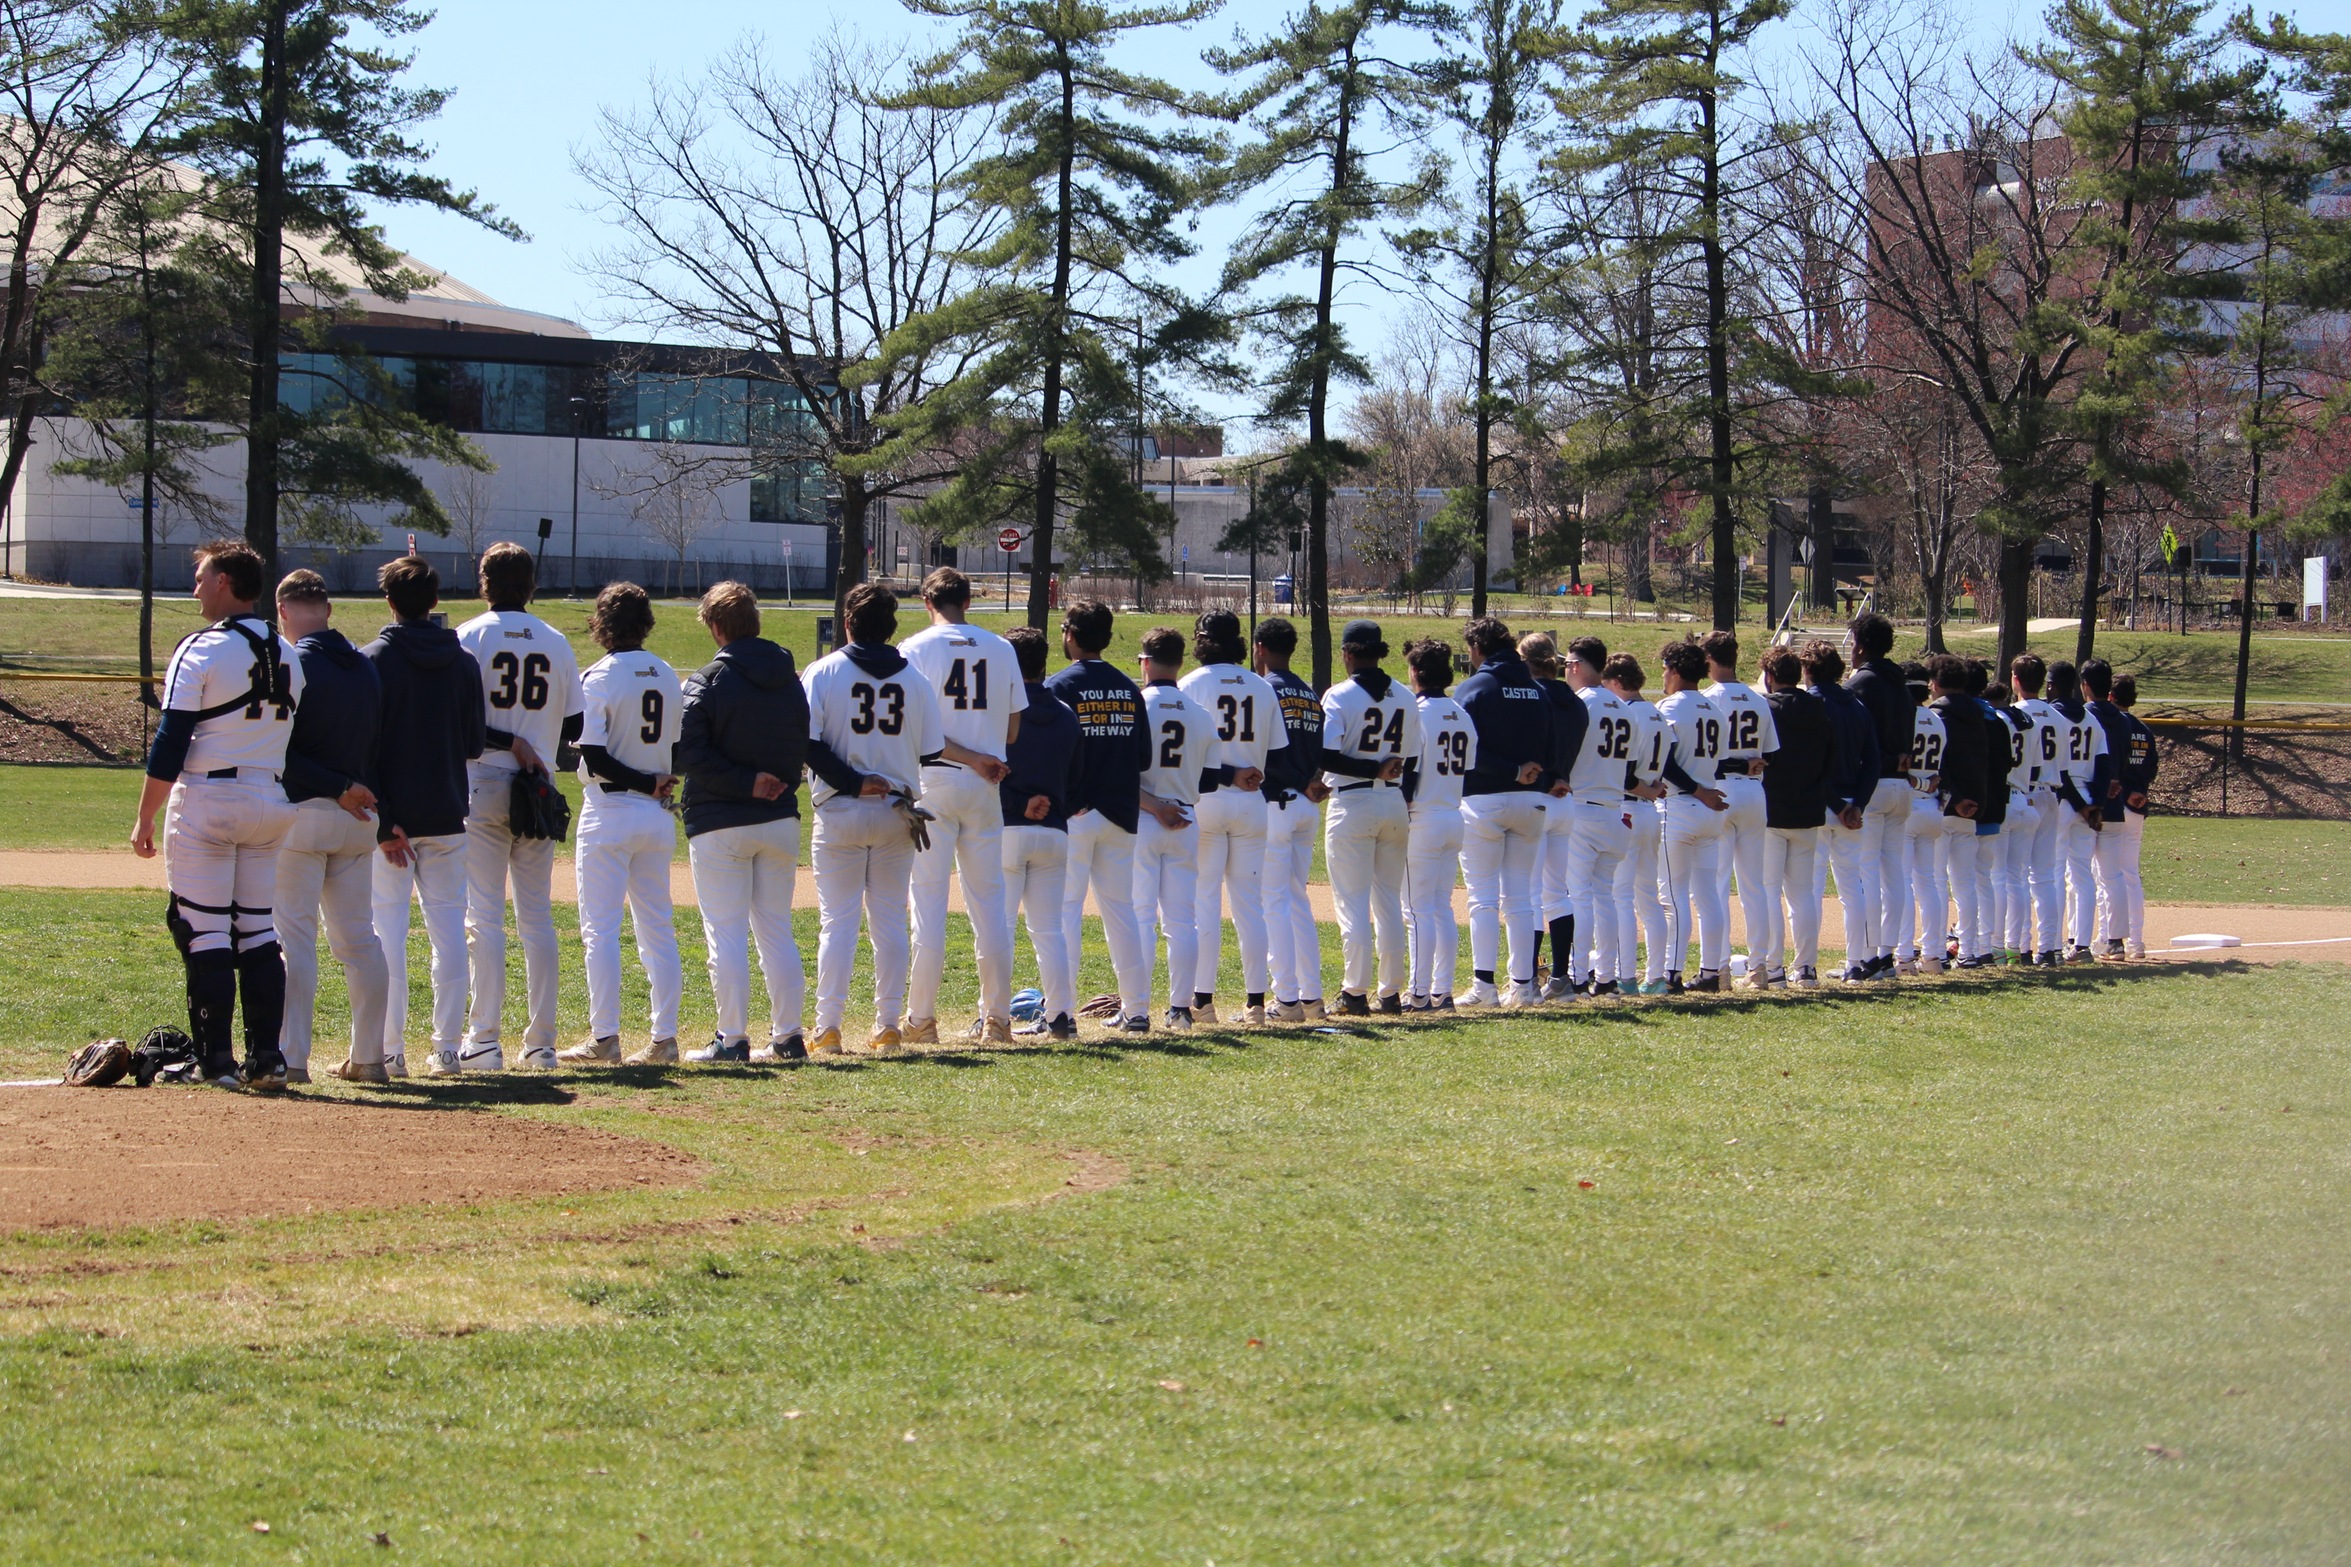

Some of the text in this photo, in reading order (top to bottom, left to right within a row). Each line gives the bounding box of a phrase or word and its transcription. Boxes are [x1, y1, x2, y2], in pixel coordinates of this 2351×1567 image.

[490, 652, 551, 710] 36
[943, 658, 988, 710] 41
[1079, 690, 1132, 701] YOU ARE
[1277, 687, 1317, 702] YOU ARE
[1502, 686, 1540, 700] CASTRO
[640, 689, 664, 744] 9
[850, 682, 905, 735] 33
[1077, 701, 1136, 713] EITHER IN
[1092, 713, 1123, 724] OR IN
[1217, 694, 1255, 742] 31
[1303, 710, 1312, 721] IN
[1311, 701, 1321, 711] IN
[1082, 725, 1133, 737] THE WAY
[1160, 720, 1185, 768] 2
[1358, 707, 1405, 754] 24
[1597, 716, 1631, 760] 32
[1694, 717, 1720, 759] 19
[1728, 710, 1759, 750] 12
[2040, 725, 2056, 761] 6
[2069, 726, 2093, 761] 21
[2131, 733, 2147, 741] ARE
[1437, 731, 1469, 776] 39
[1648, 730, 1661, 772] 1
[1912, 733, 1942, 770] 22
[2129, 757, 2145, 765] WAY
